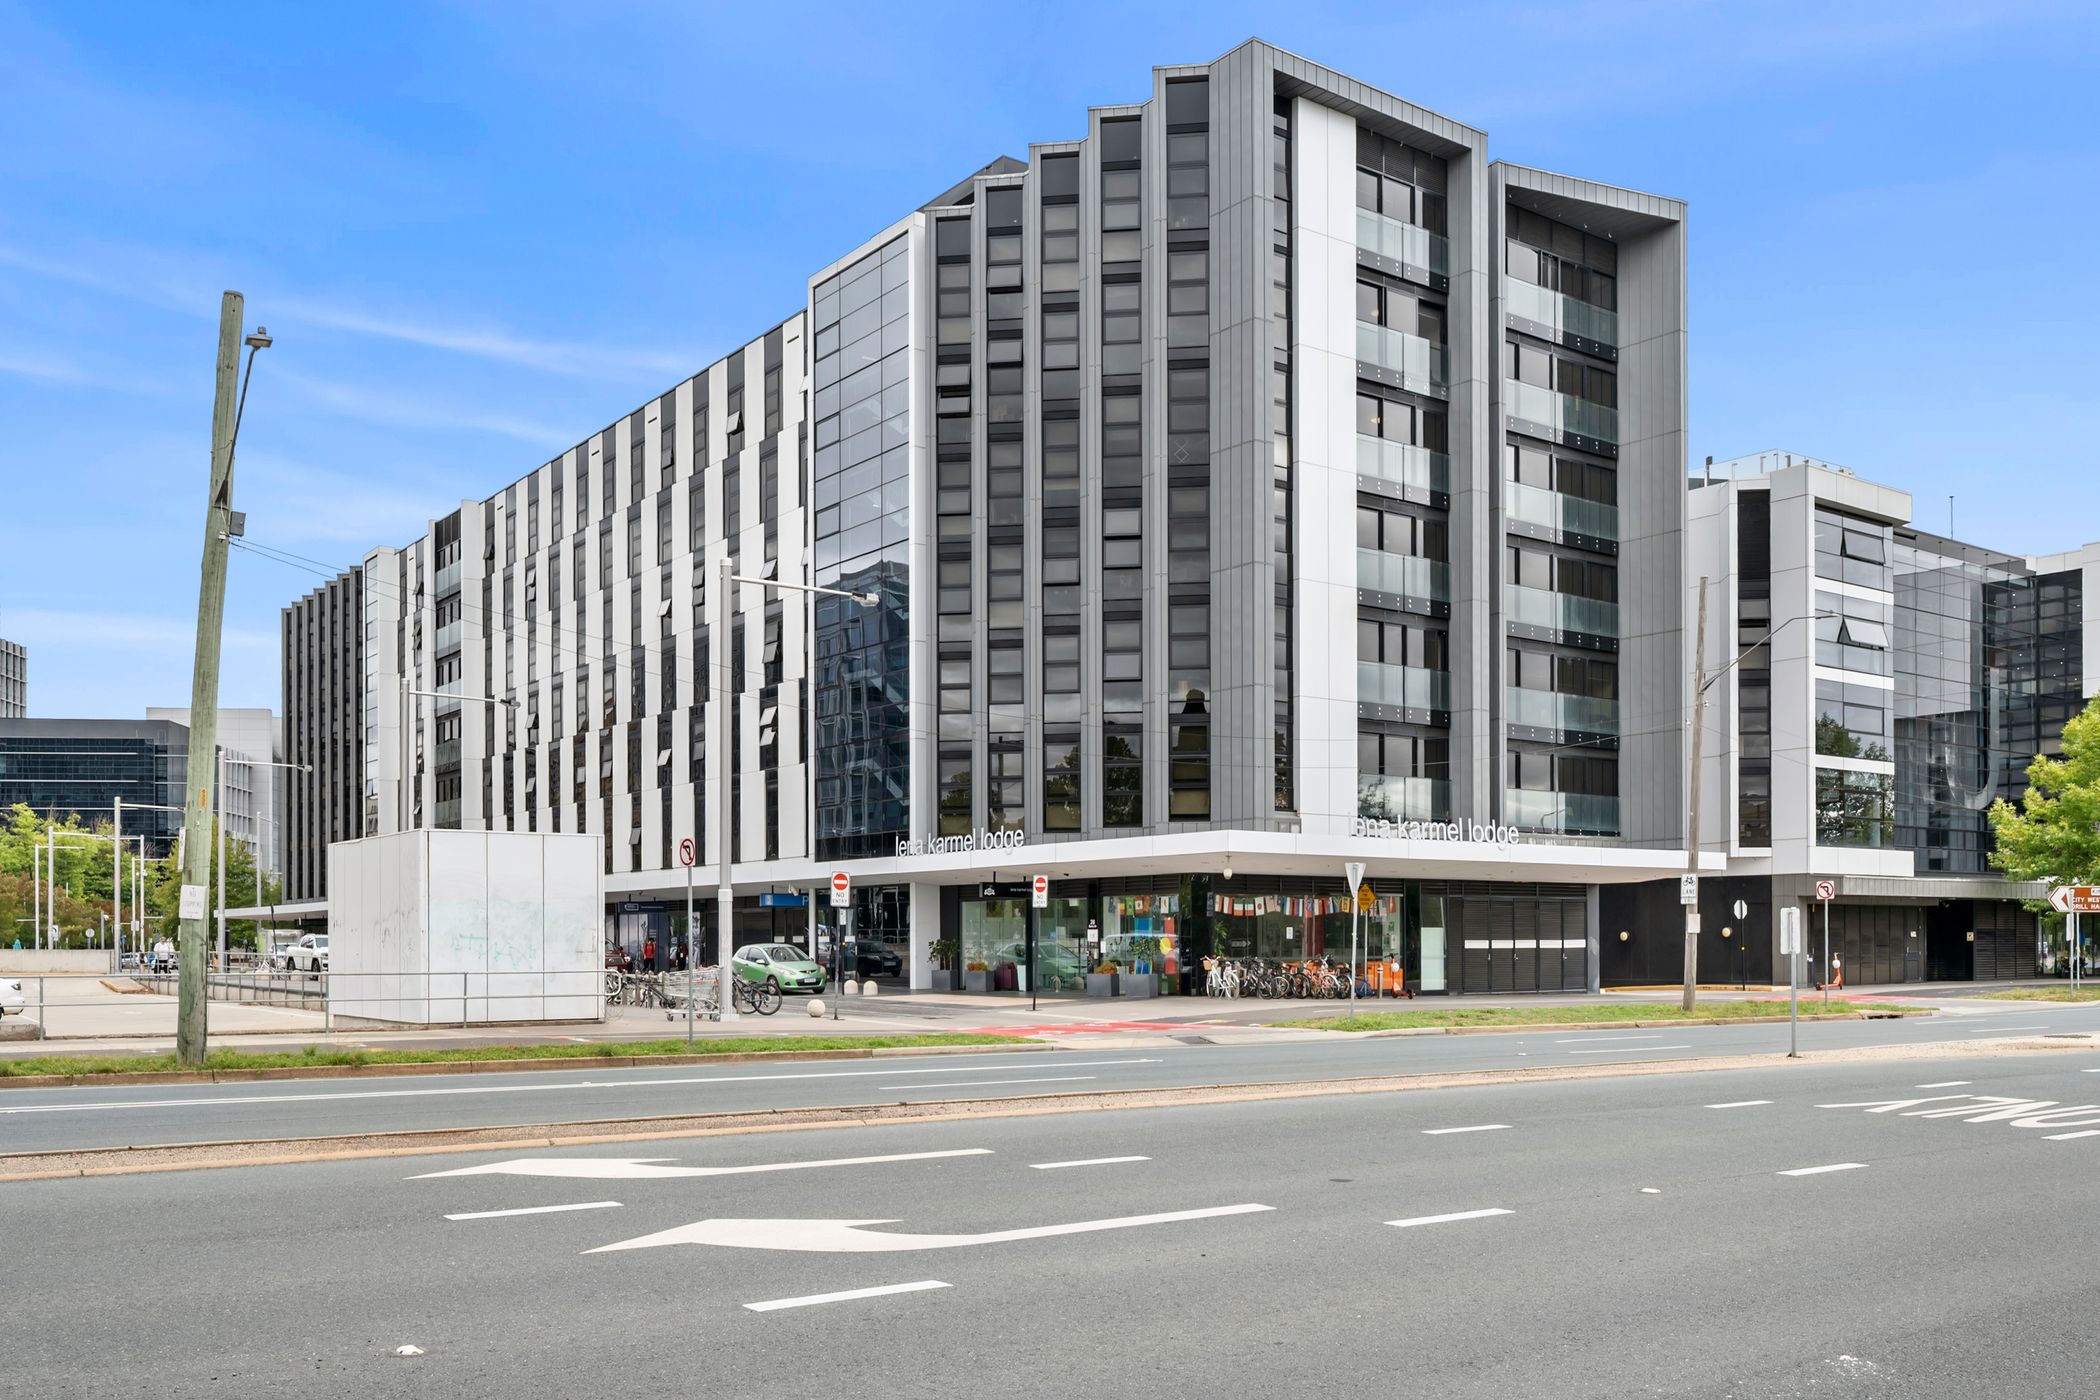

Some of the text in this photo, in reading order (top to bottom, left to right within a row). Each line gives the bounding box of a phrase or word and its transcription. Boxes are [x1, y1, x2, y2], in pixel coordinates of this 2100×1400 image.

[895, 824, 1025, 857] lena karmel lodge
[1397, 814, 1464, 842] karmel
[1468, 817, 1520, 850] lodge
